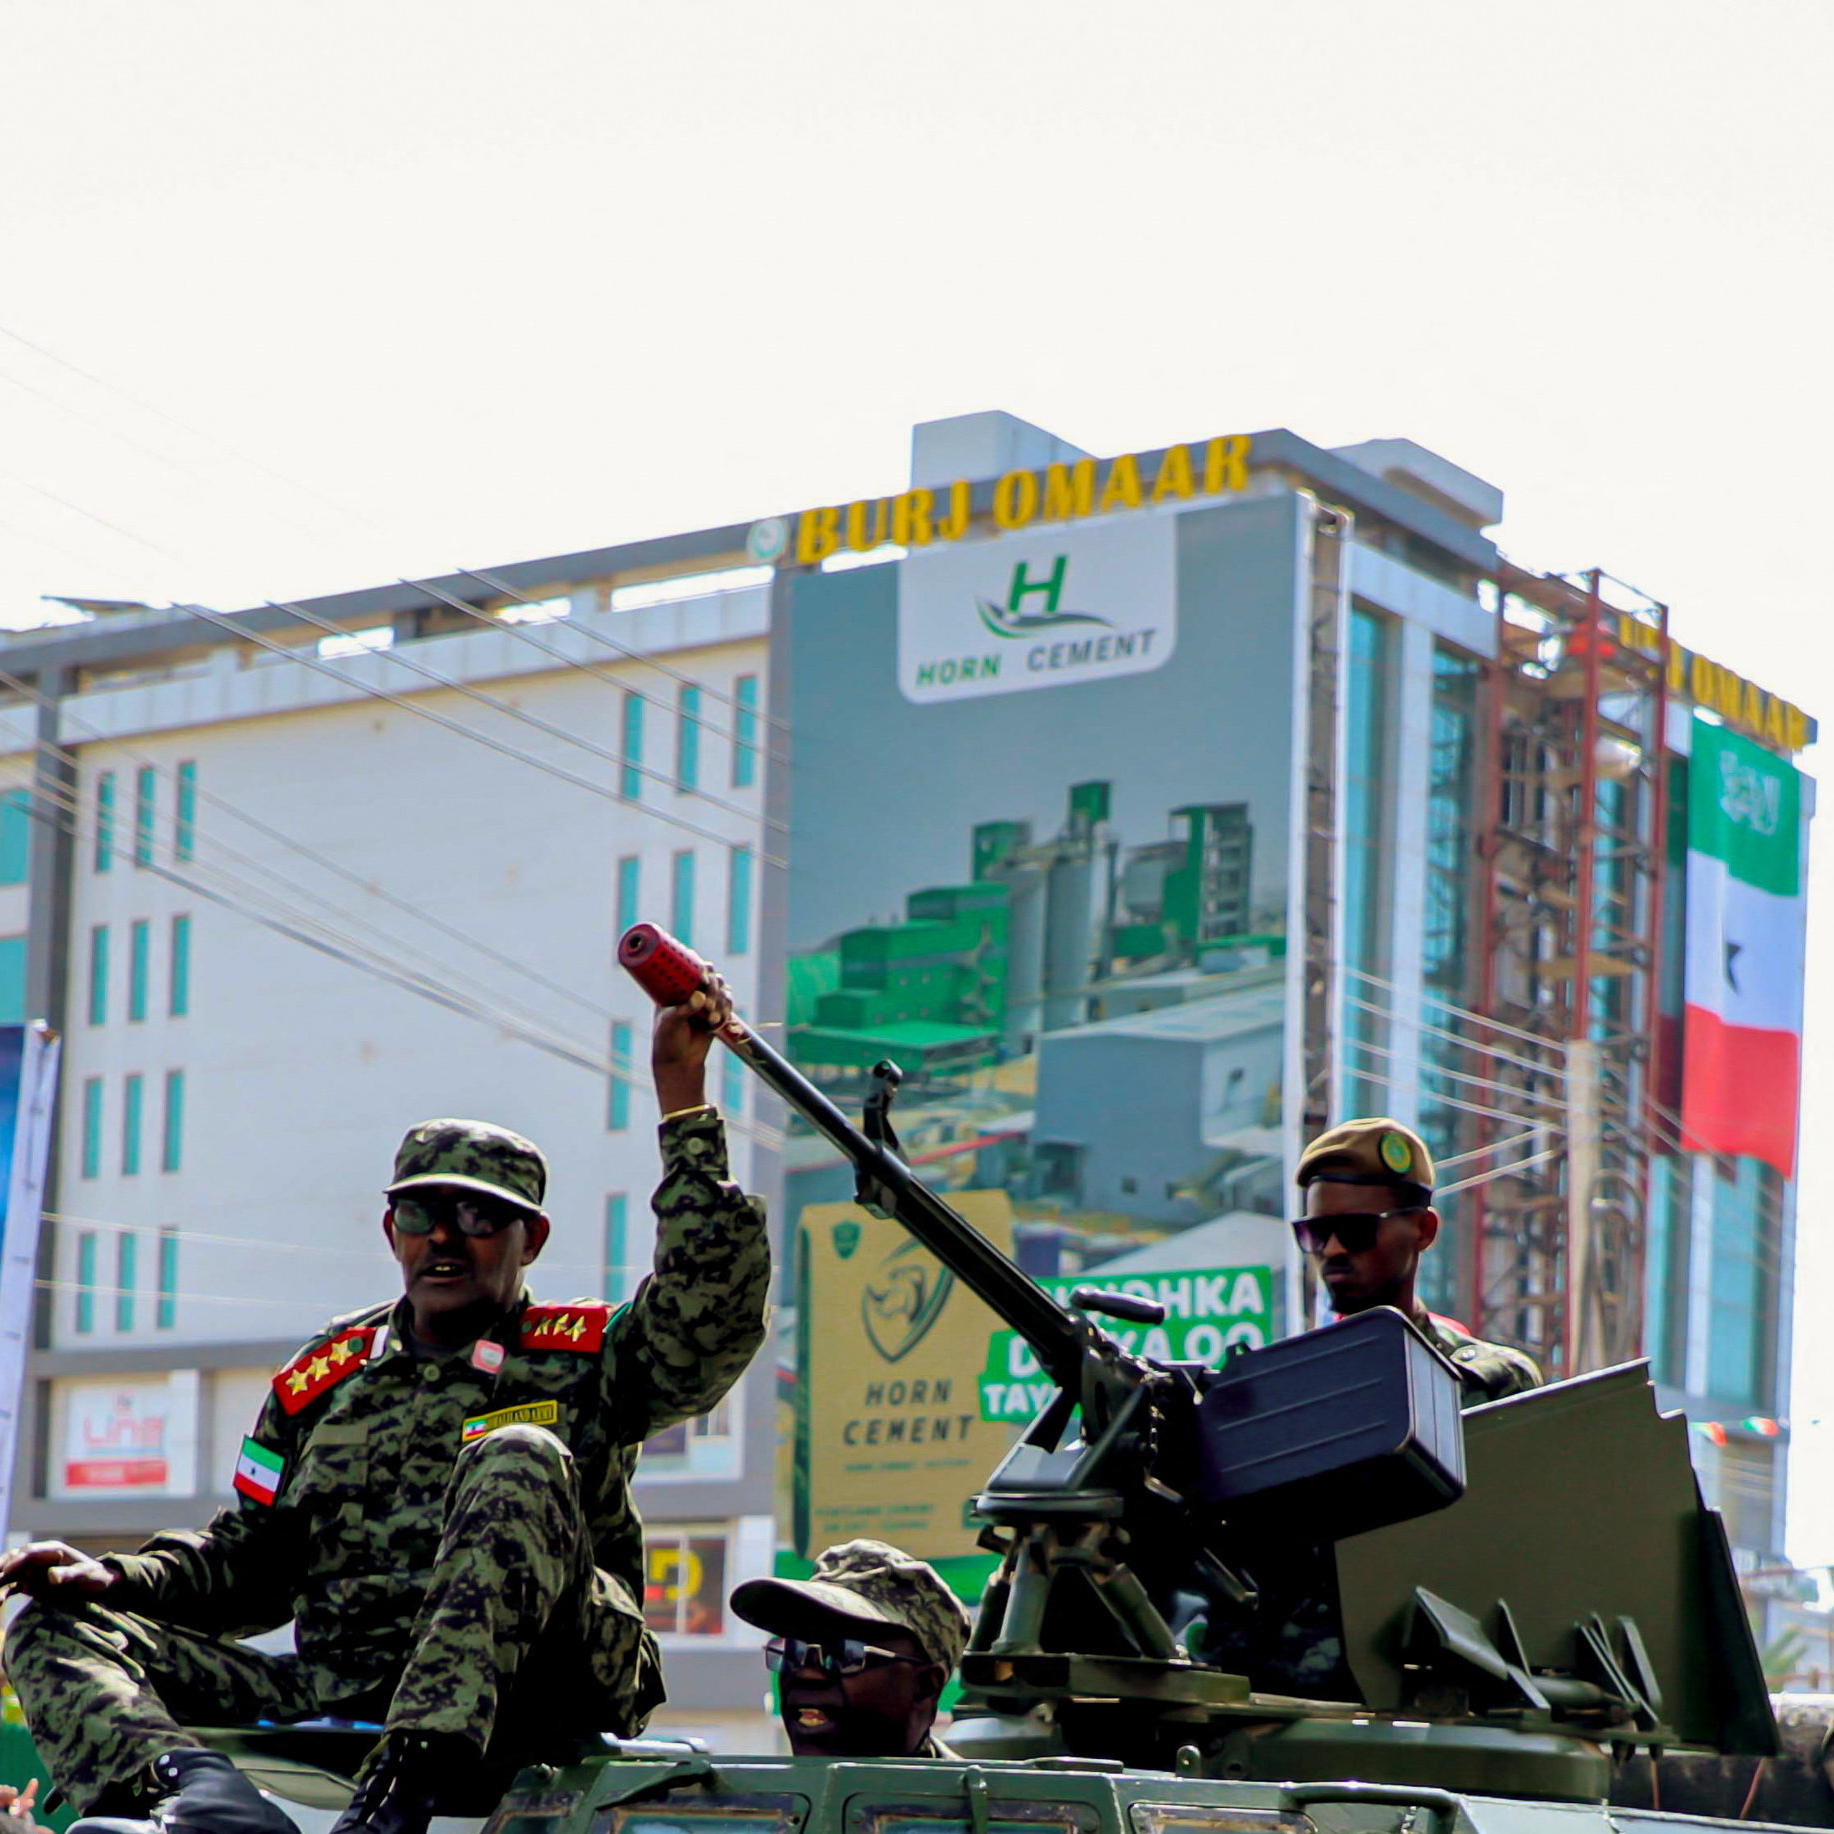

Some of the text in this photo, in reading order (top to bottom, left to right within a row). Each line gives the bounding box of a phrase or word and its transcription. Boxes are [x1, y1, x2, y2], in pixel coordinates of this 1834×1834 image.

[796, 433, 1252, 565] BURJ OMAAR
[915, 629, 1157, 687] HORN CEMENT
[864, 1377, 953, 1408] HORN
[842, 1413, 976, 1447] CEMENT
